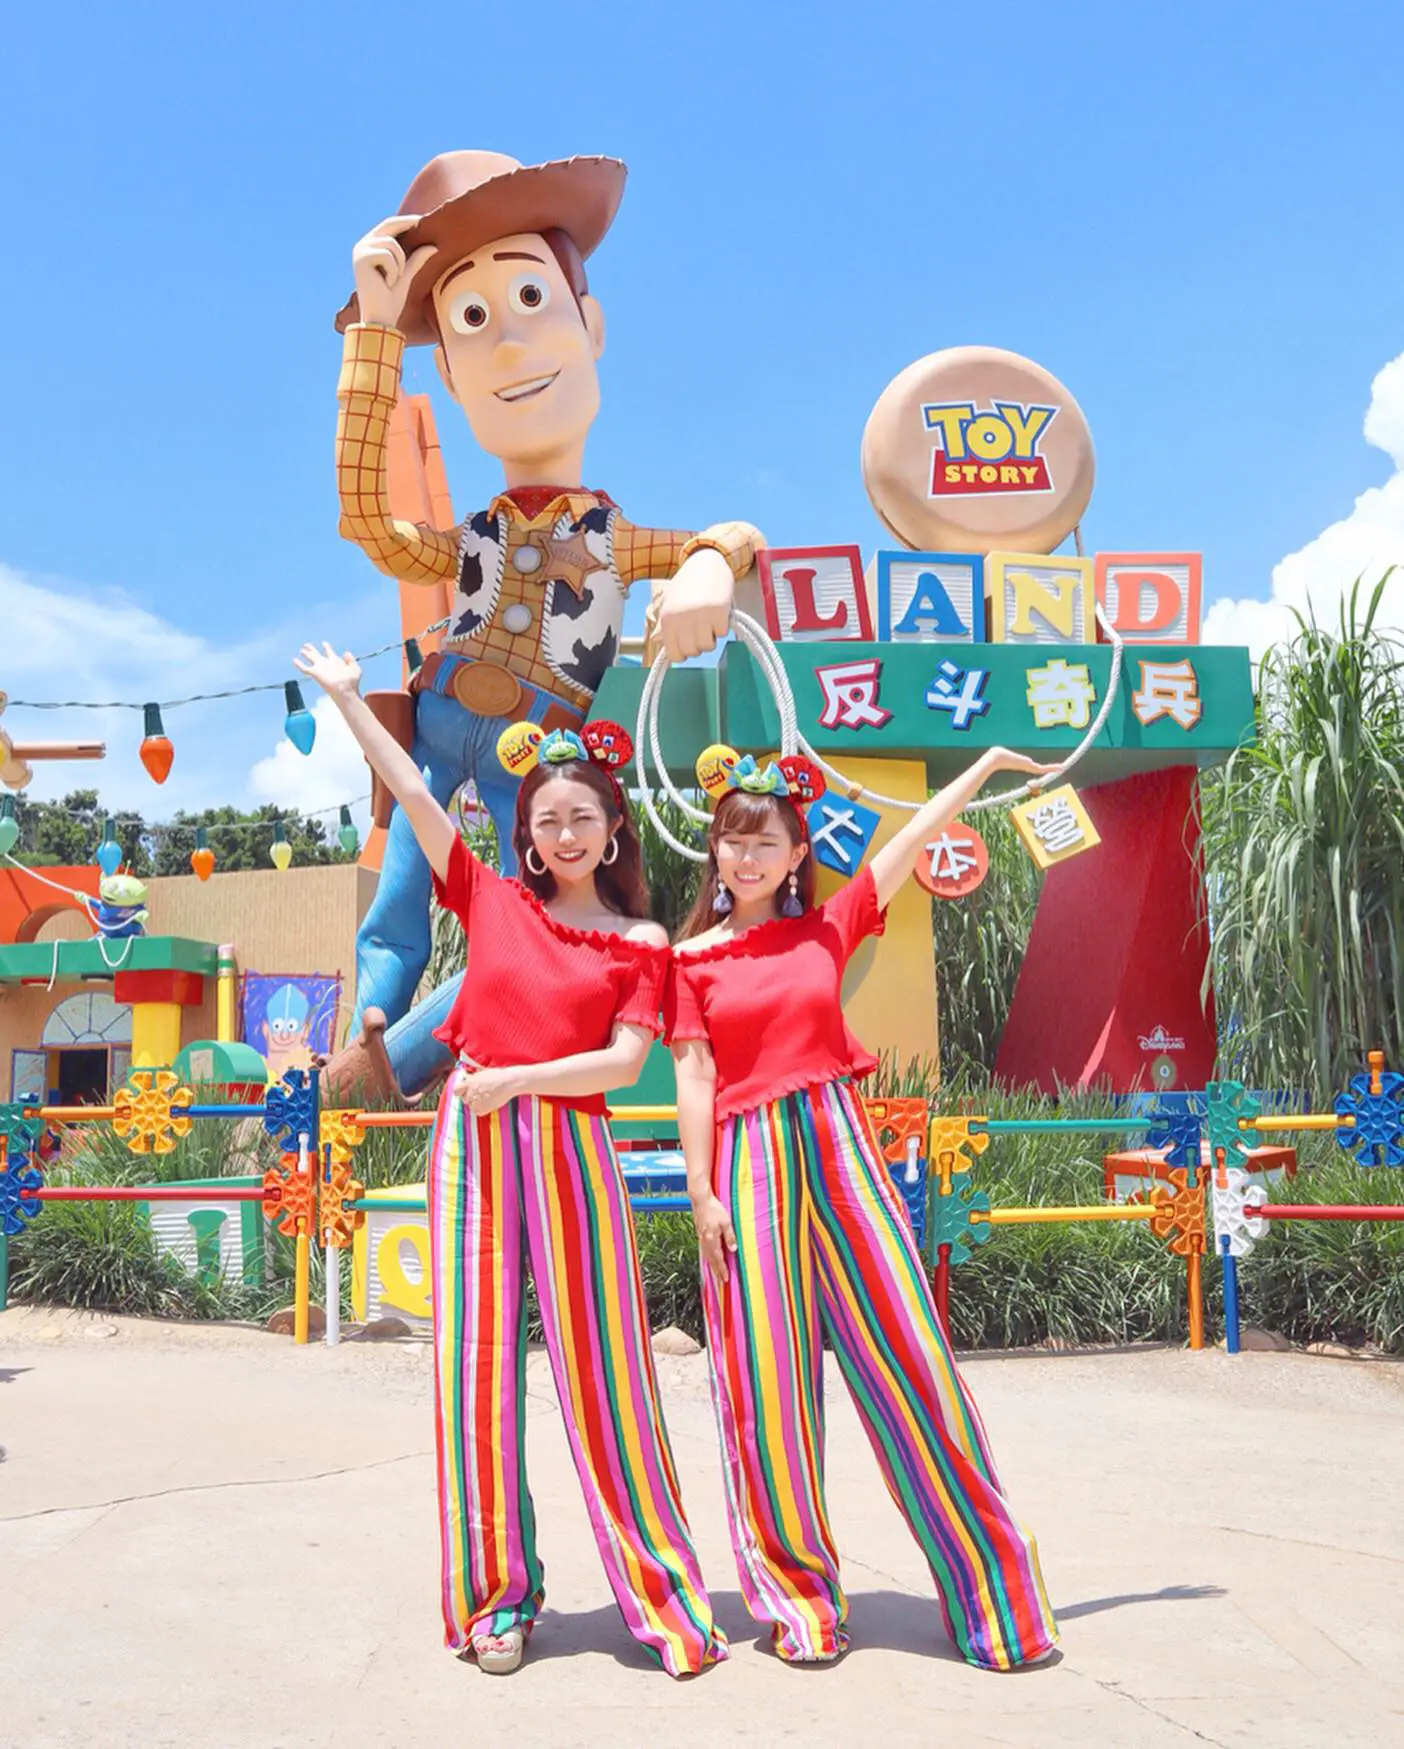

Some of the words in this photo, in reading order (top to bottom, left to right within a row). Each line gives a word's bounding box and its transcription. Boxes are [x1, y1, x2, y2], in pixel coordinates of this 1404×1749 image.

[924, 401, 1058, 463] TOY
[944, 464, 1039, 485] STORY
[782, 567, 1182, 637] LAND
[815, 658, 1202, 731] 反斗奇兵
